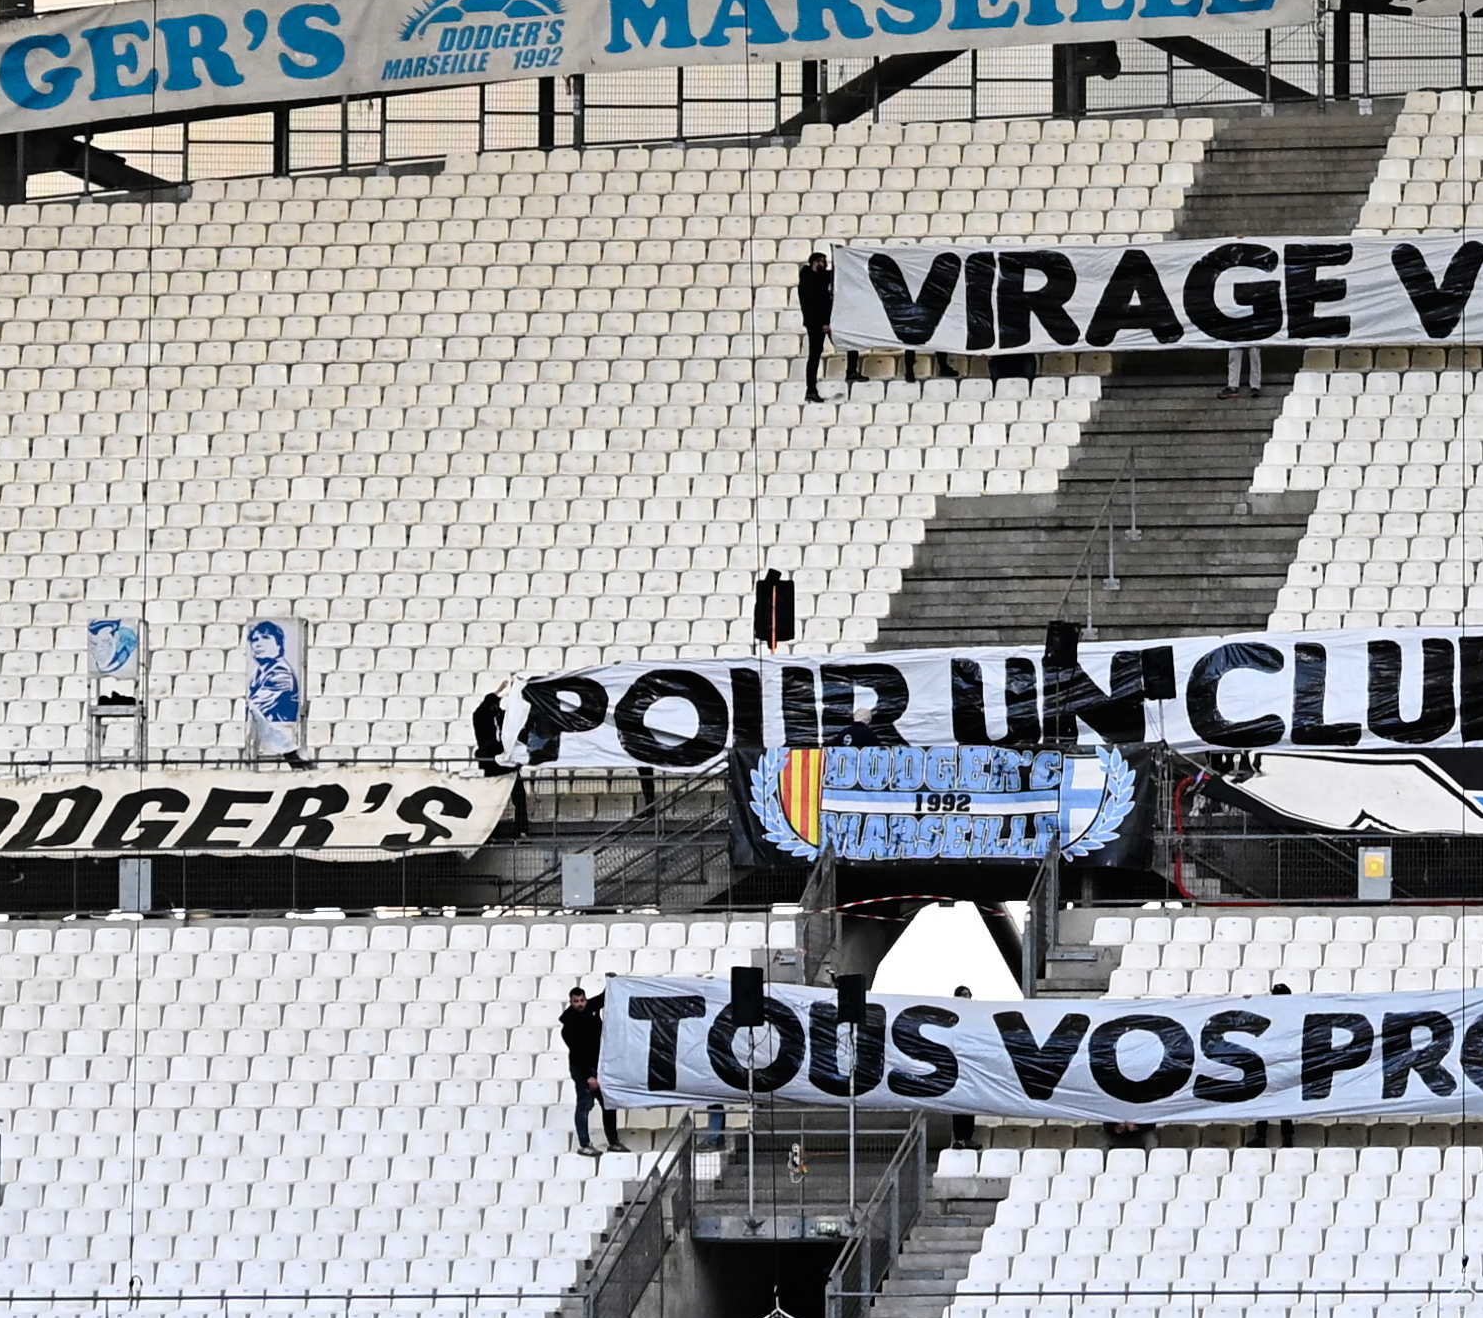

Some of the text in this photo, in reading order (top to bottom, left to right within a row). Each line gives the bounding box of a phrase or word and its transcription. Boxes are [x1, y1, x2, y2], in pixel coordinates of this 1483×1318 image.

[437, 18, 565, 52] DODGER'S
[382, 46, 564, 81] MARSEILLE 1992
[867, 241, 1353, 351] VIRAGE
[519, 662, 910, 767] POUR
[950, 644, 1151, 747] UN
[823, 745, 1062, 791] DODGER'S
[915, 793, 972, 813] 1992
[820, 813, 1058, 860] MARSEILLE
[628, 996, 960, 1098] TOUS
[993, 1010, 1270, 1103] VOS
